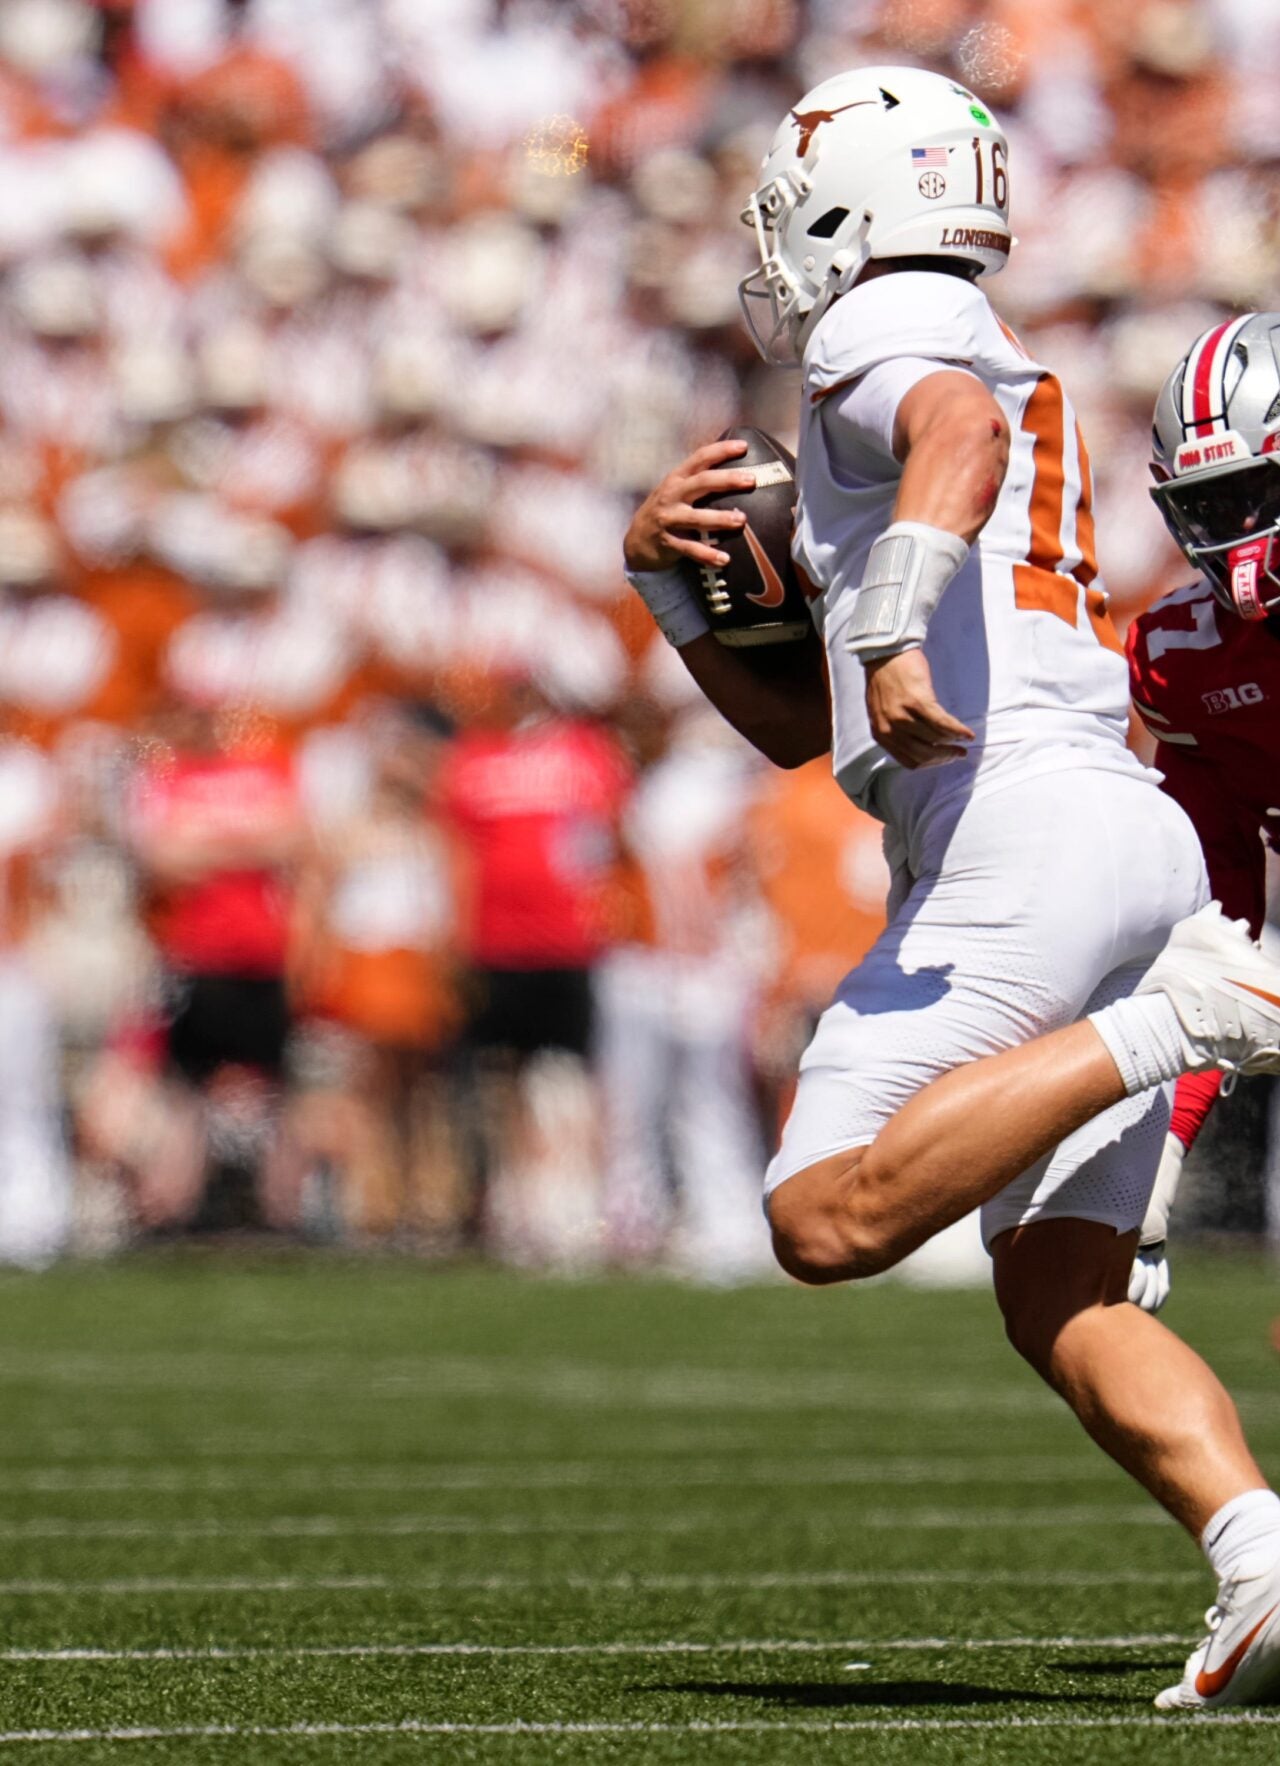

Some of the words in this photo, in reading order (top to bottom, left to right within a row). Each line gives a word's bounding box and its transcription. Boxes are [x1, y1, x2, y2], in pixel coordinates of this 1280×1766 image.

[919, 172, 946, 199] SEC
[972, 137, 1009, 209] 16
[1204, 441, 1235, 463] STATE
